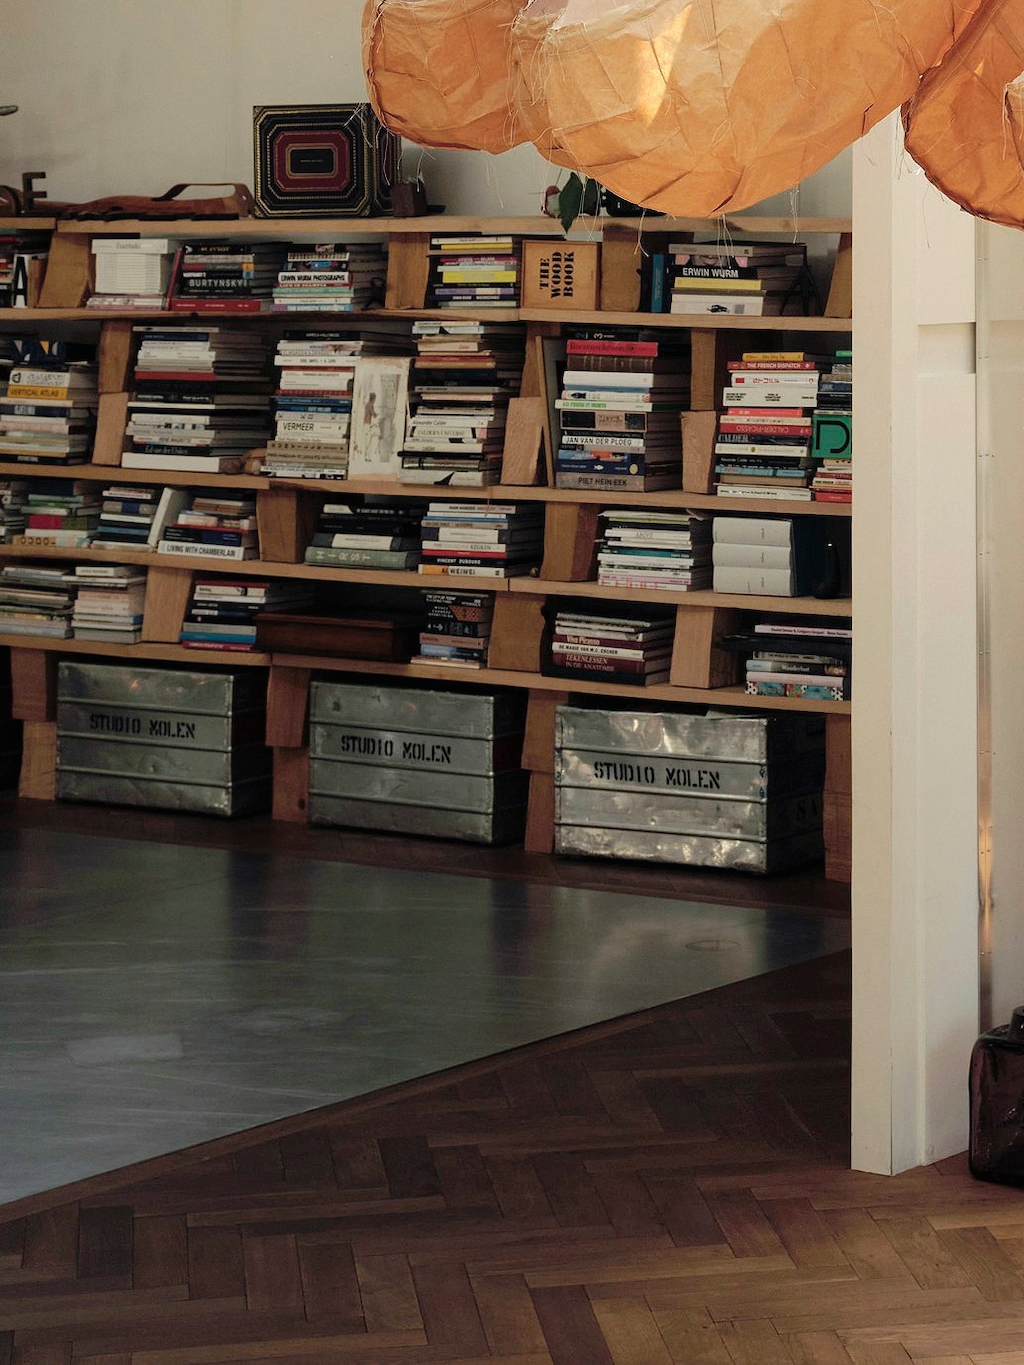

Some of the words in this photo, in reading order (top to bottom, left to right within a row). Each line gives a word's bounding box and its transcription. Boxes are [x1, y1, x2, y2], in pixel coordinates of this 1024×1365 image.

[540, 258, 550, 290] THE
[551, 251, 562, 298] WOOD
[563, 251, 574, 297] BOOK
[682, 268, 709, 276] ERWIN
[711, 269, 739, 278] WURM
[283, 422, 314, 431] VERMEER
[718, 434, 748, 443] CALDER
[199, 547, 236, 556] CHAMBERLAIN
[316, 551, 371, 561] HIRST
[579, 636, 600, 645] Picasso
[566, 655, 608, 664] TEKENLESSEN
[90, 714, 141, 733] STUDIO
[149, 720, 195, 739] MOLEN
[341, 735, 394, 757] STUDIO
[403, 742, 451, 764] MOLEN
[594, 761, 655, 784] STUDIO
[666, 767, 720, 789] MOLEN
